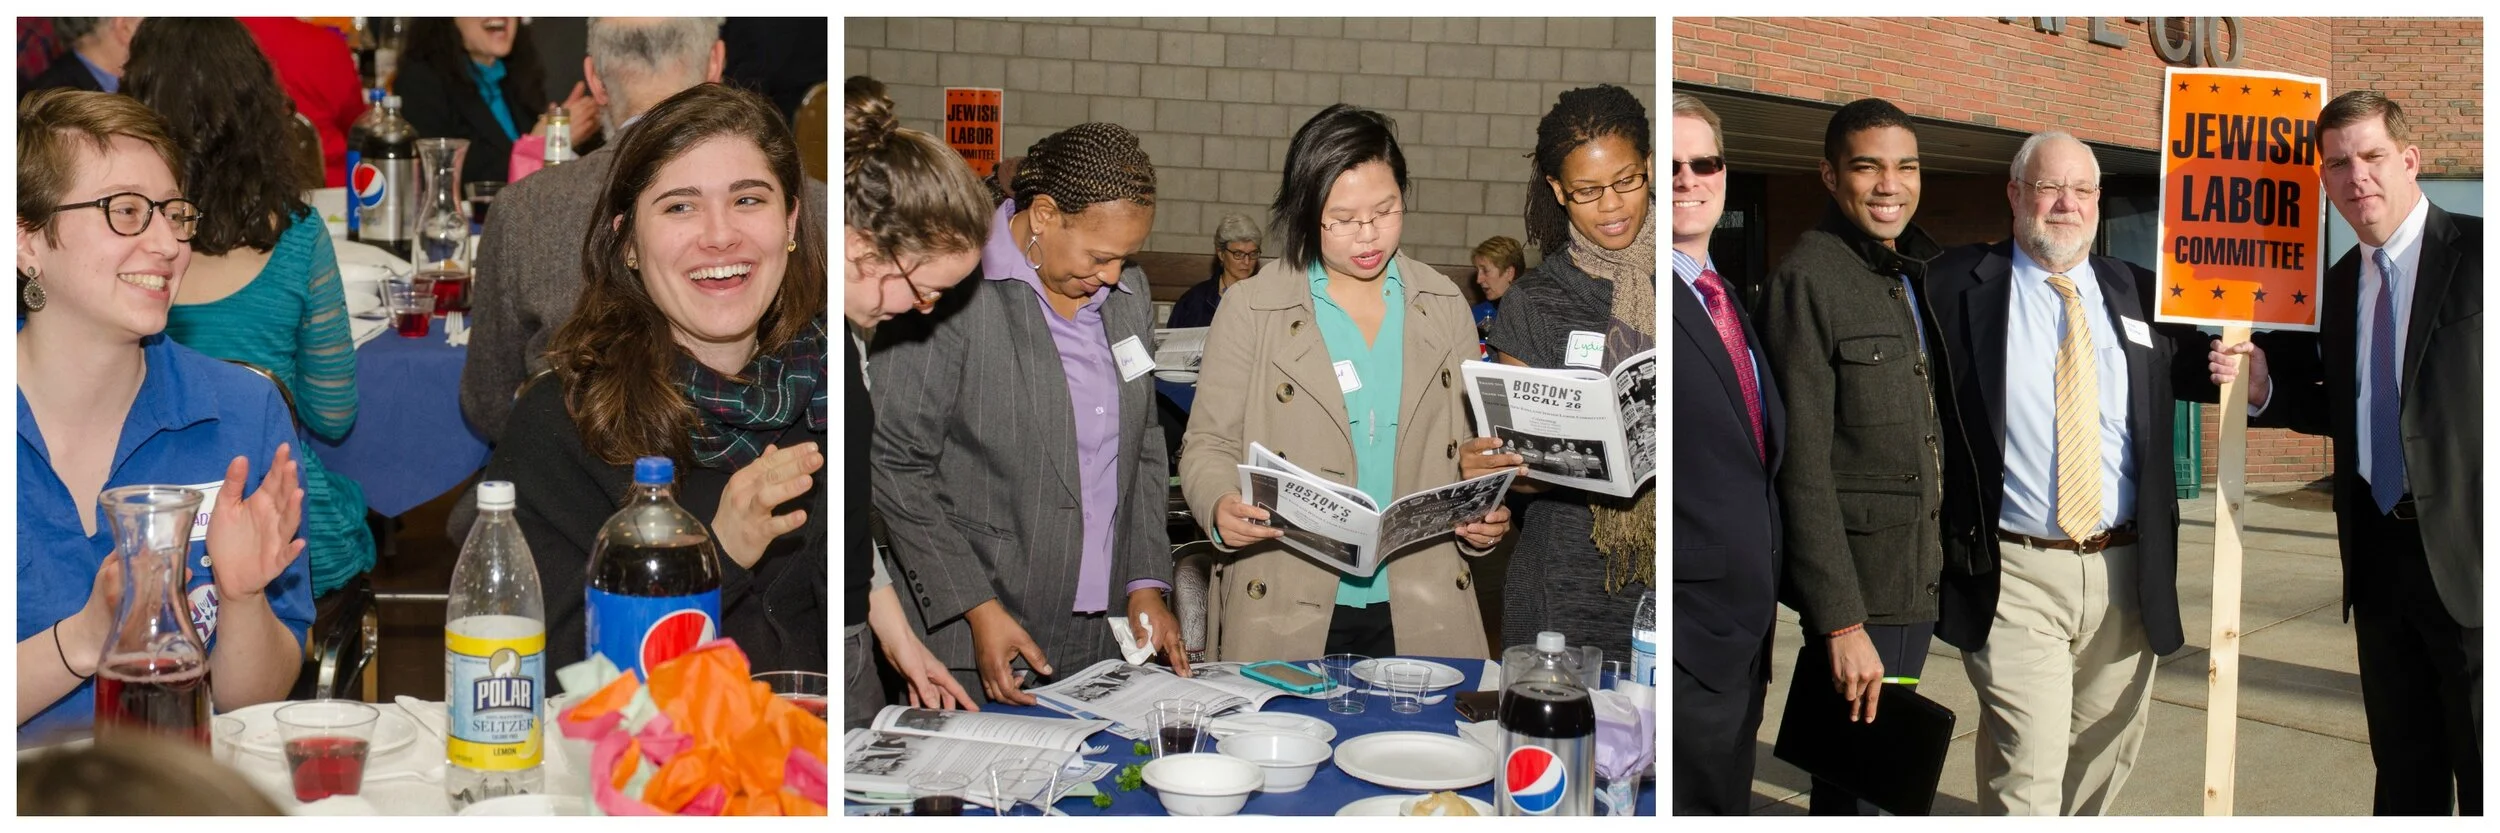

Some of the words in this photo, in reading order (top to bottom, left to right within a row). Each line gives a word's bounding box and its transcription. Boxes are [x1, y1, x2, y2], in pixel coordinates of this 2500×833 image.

[947, 104, 999, 122] JEWISH
[951, 127, 994, 144] LABOR
[2172, 112, 2316, 166] JEWISH
[957, 148, 995, 160] MMITTEE
[2181, 174, 2300, 228] LABOR
[2175, 235, 2305, 271] COMMITTEE
[1513, 380, 1582, 402] BOSTON'S
[1513, 392, 1560, 407] LOCAL
[1565, 401, 1582, 409] 26
[1284, 488, 1327, 514] LOCAL
[1285, 481, 1352, 518] BOSTON'S
[477, 679, 531, 709] POLAR
[472, 718, 534, 733] SELTZER
[493, 748, 517, 756] LEMON
